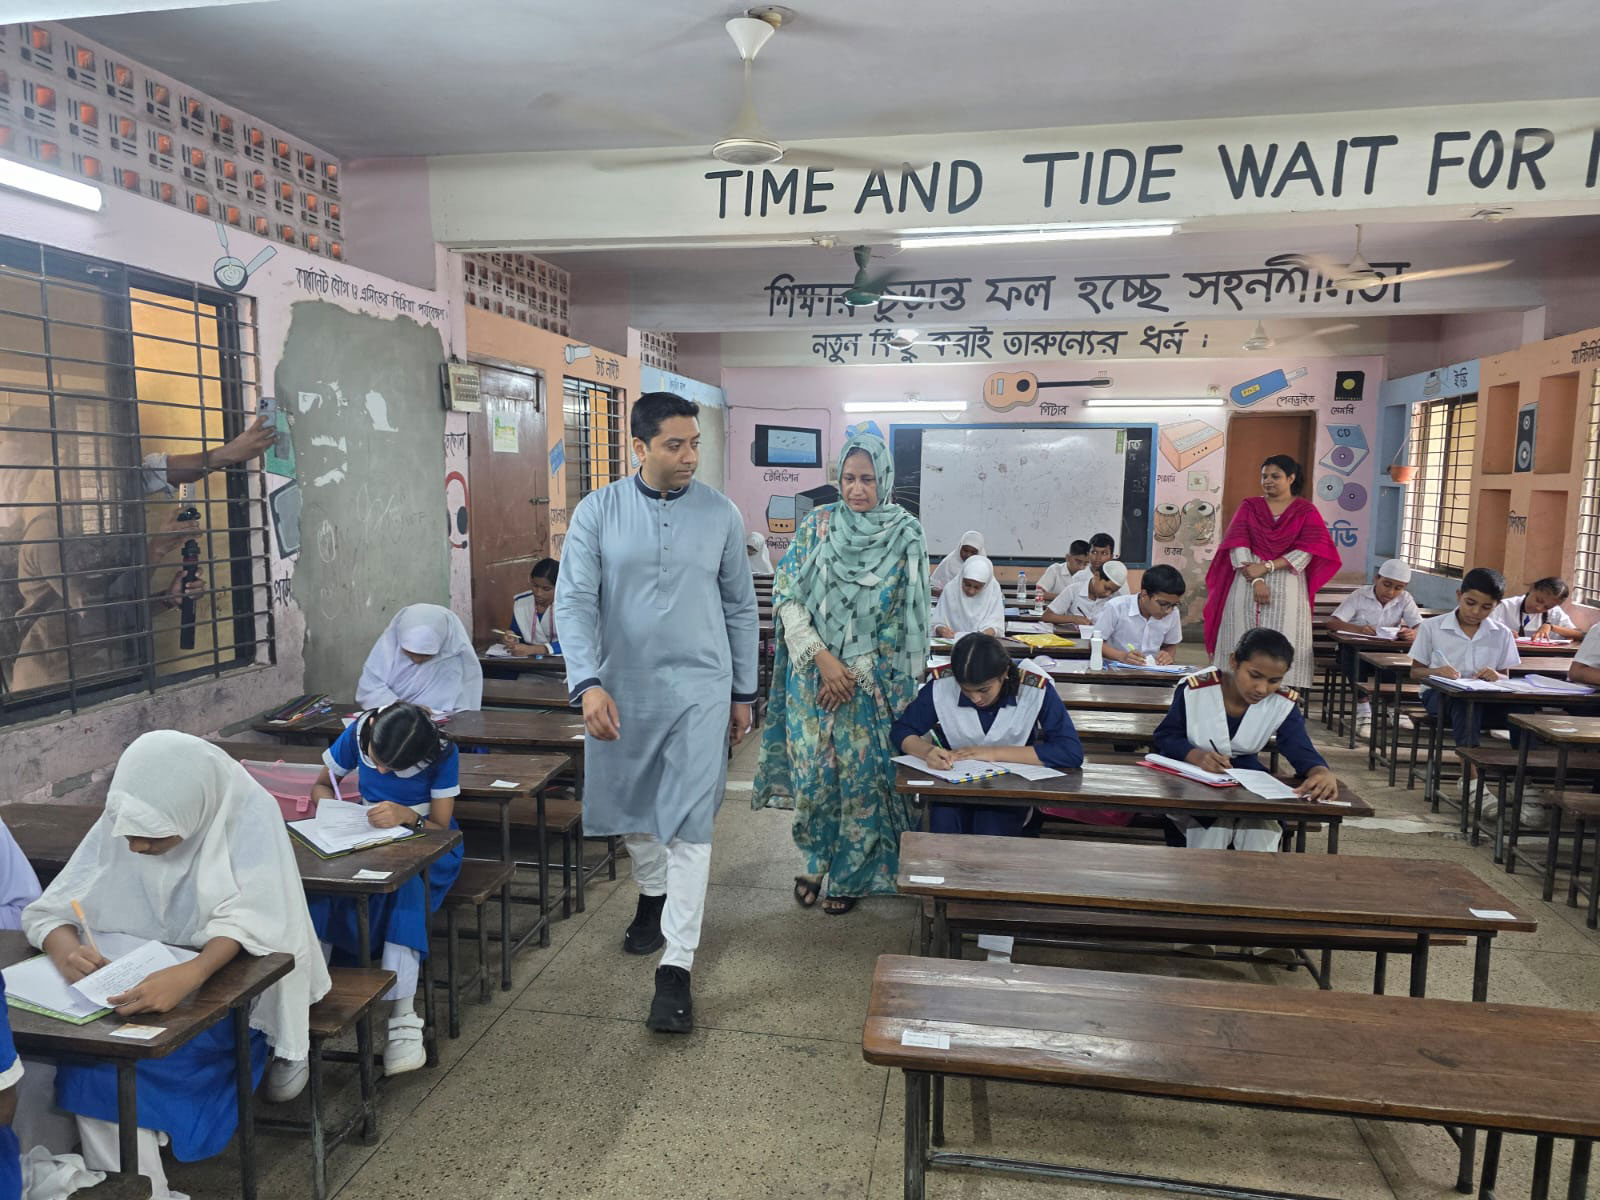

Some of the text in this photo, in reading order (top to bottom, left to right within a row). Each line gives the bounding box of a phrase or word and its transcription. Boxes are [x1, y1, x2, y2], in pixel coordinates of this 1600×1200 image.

[705, 167, 834, 219] TIME
[854, 160, 983, 214] AND
[1022, 145, 1183, 207] TIDE
[1218, 135, 1399, 199] WAIT
[1427, 128, 1555, 196] FOR
[985, 275, 1056, 311] ফল
[1074, 273, 1170, 313] হচ্ছে
[812, 333, 862, 363] নতুন
[927, 326, 994, 359] করাই
[1139, 321, 1189, 355] ধর্ম
[1039, 401, 1070, 416] গিটার
[1337, 428, 1351, 438] CD
